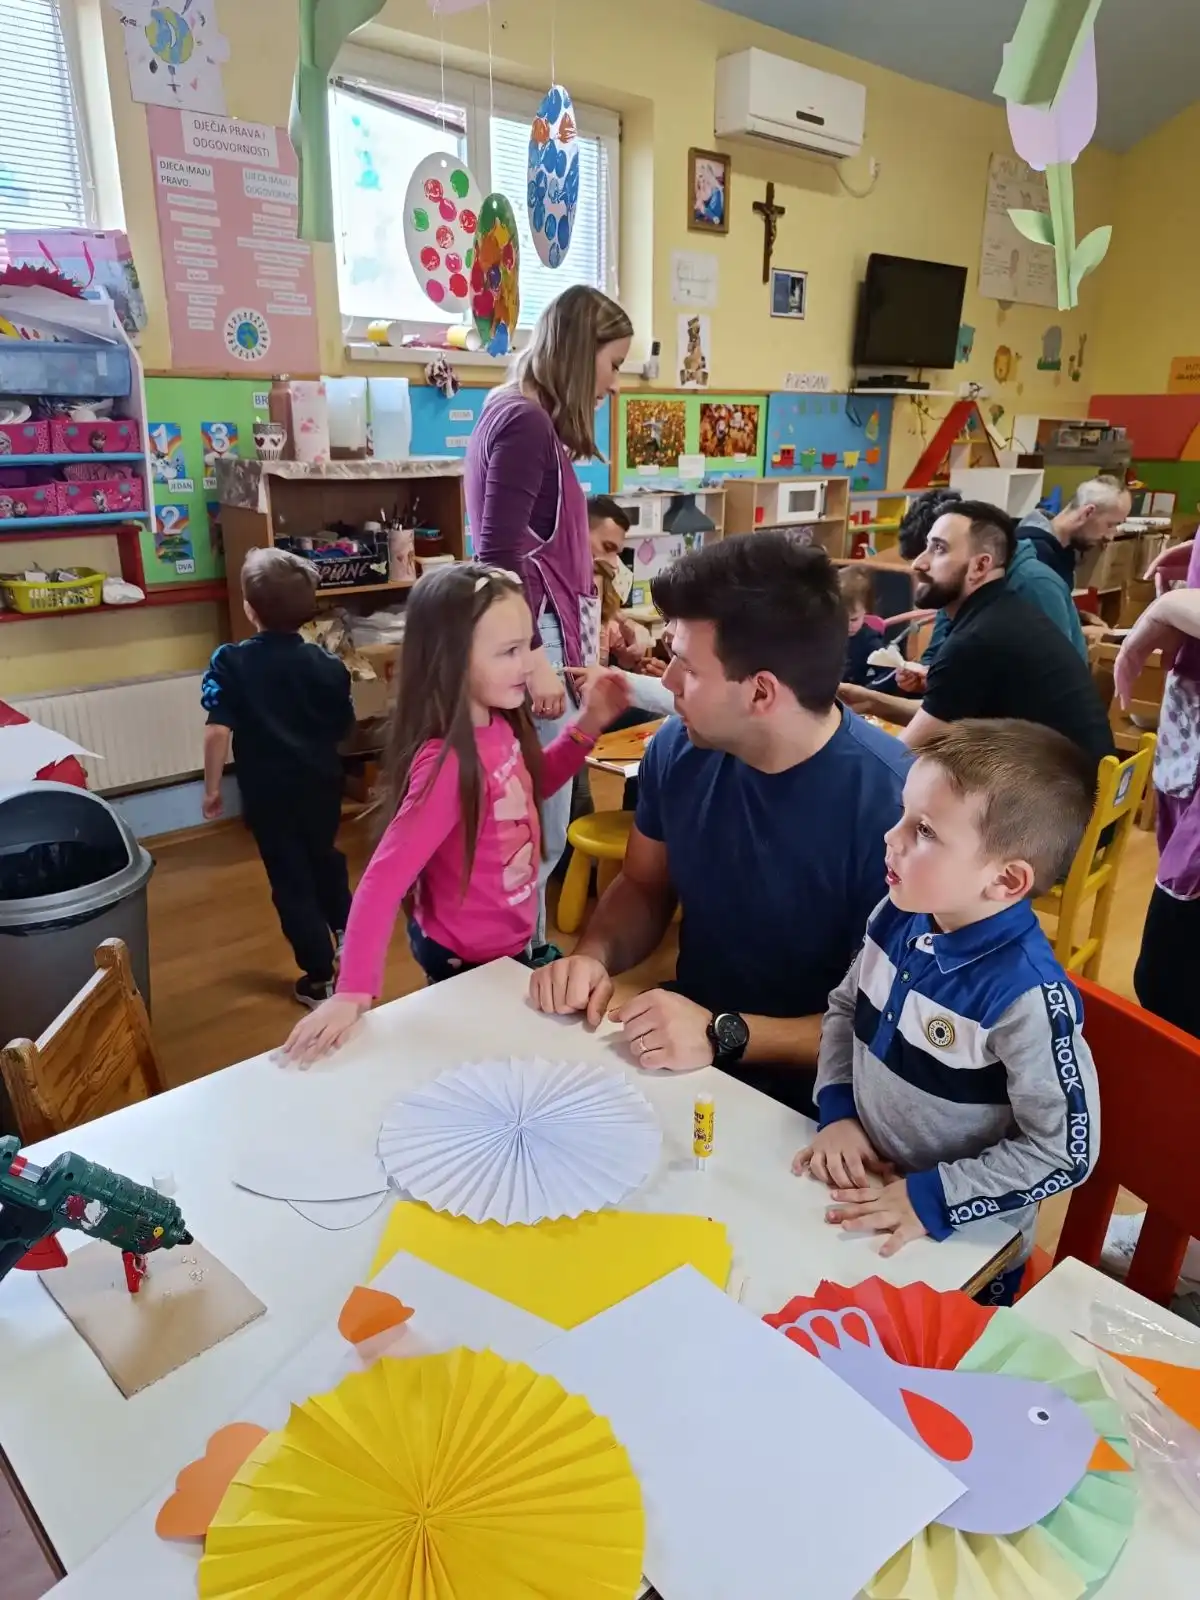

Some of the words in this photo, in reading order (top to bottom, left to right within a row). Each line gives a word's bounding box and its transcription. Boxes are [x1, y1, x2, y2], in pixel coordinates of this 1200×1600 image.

[229, 125, 261, 139] PRAVA
[192, 136, 270, 157] ODGOVORNOSTI
[159, 160, 184, 172] DJECA
[186, 164, 211, 176] IMAJU
[170, 481, 193, 491] JEDAN
[178, 563, 193, 571] DVA
[1055, 1036, 1082, 1093] ROCK
[1070, 1112, 1088, 1167] ROCK
[1016, 1171, 1073, 1206] ROCK
[949, 1199, 1001, 1223] ROCK
